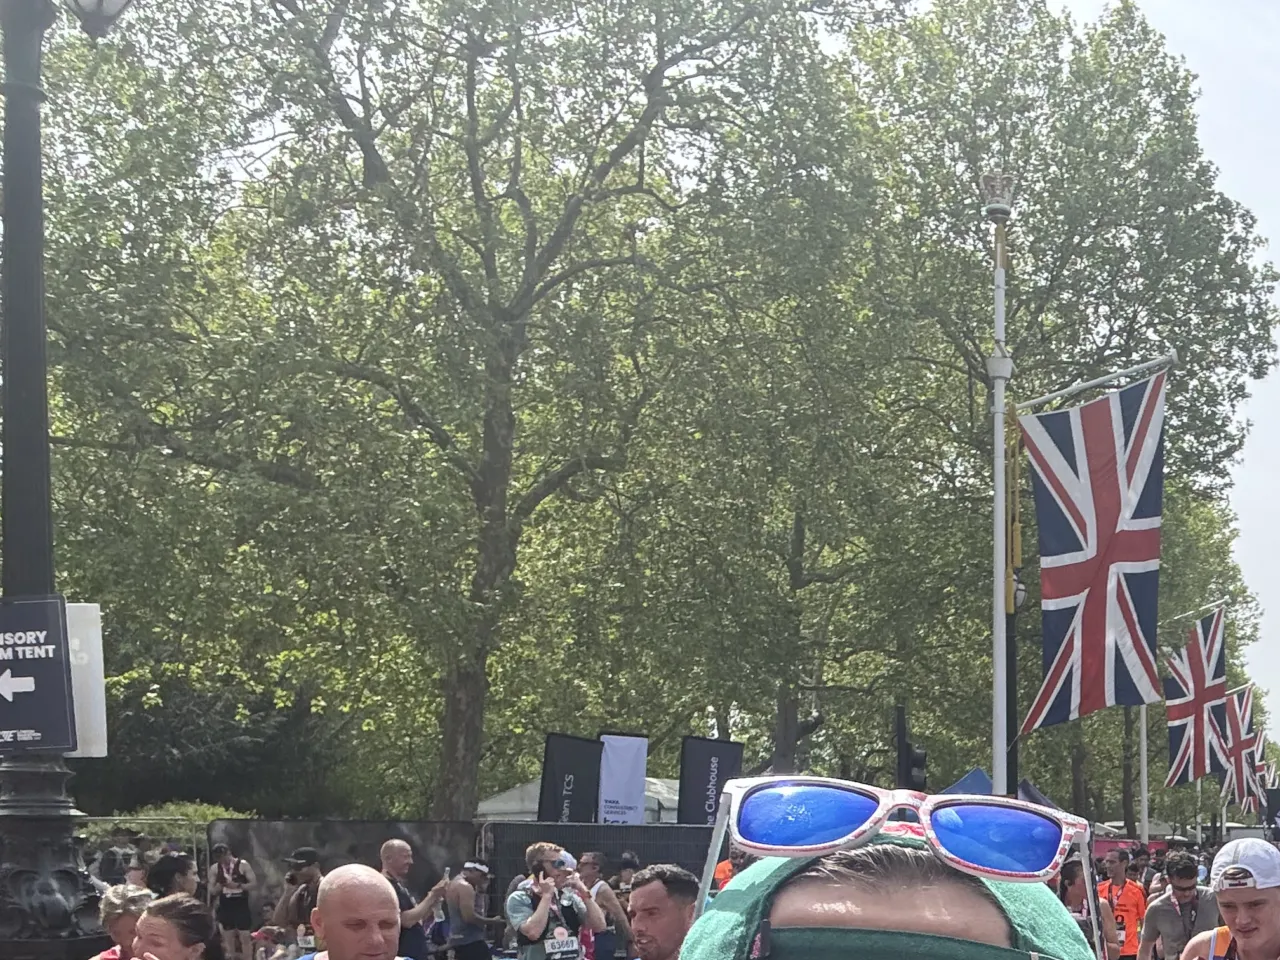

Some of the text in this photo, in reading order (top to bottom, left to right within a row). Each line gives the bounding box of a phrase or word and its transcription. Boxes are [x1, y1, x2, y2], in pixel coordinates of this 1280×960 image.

[15, 645, 56, 660] TENT
[562, 774, 574, 796] TCS
[704, 756, 719, 813] Clubhouse
